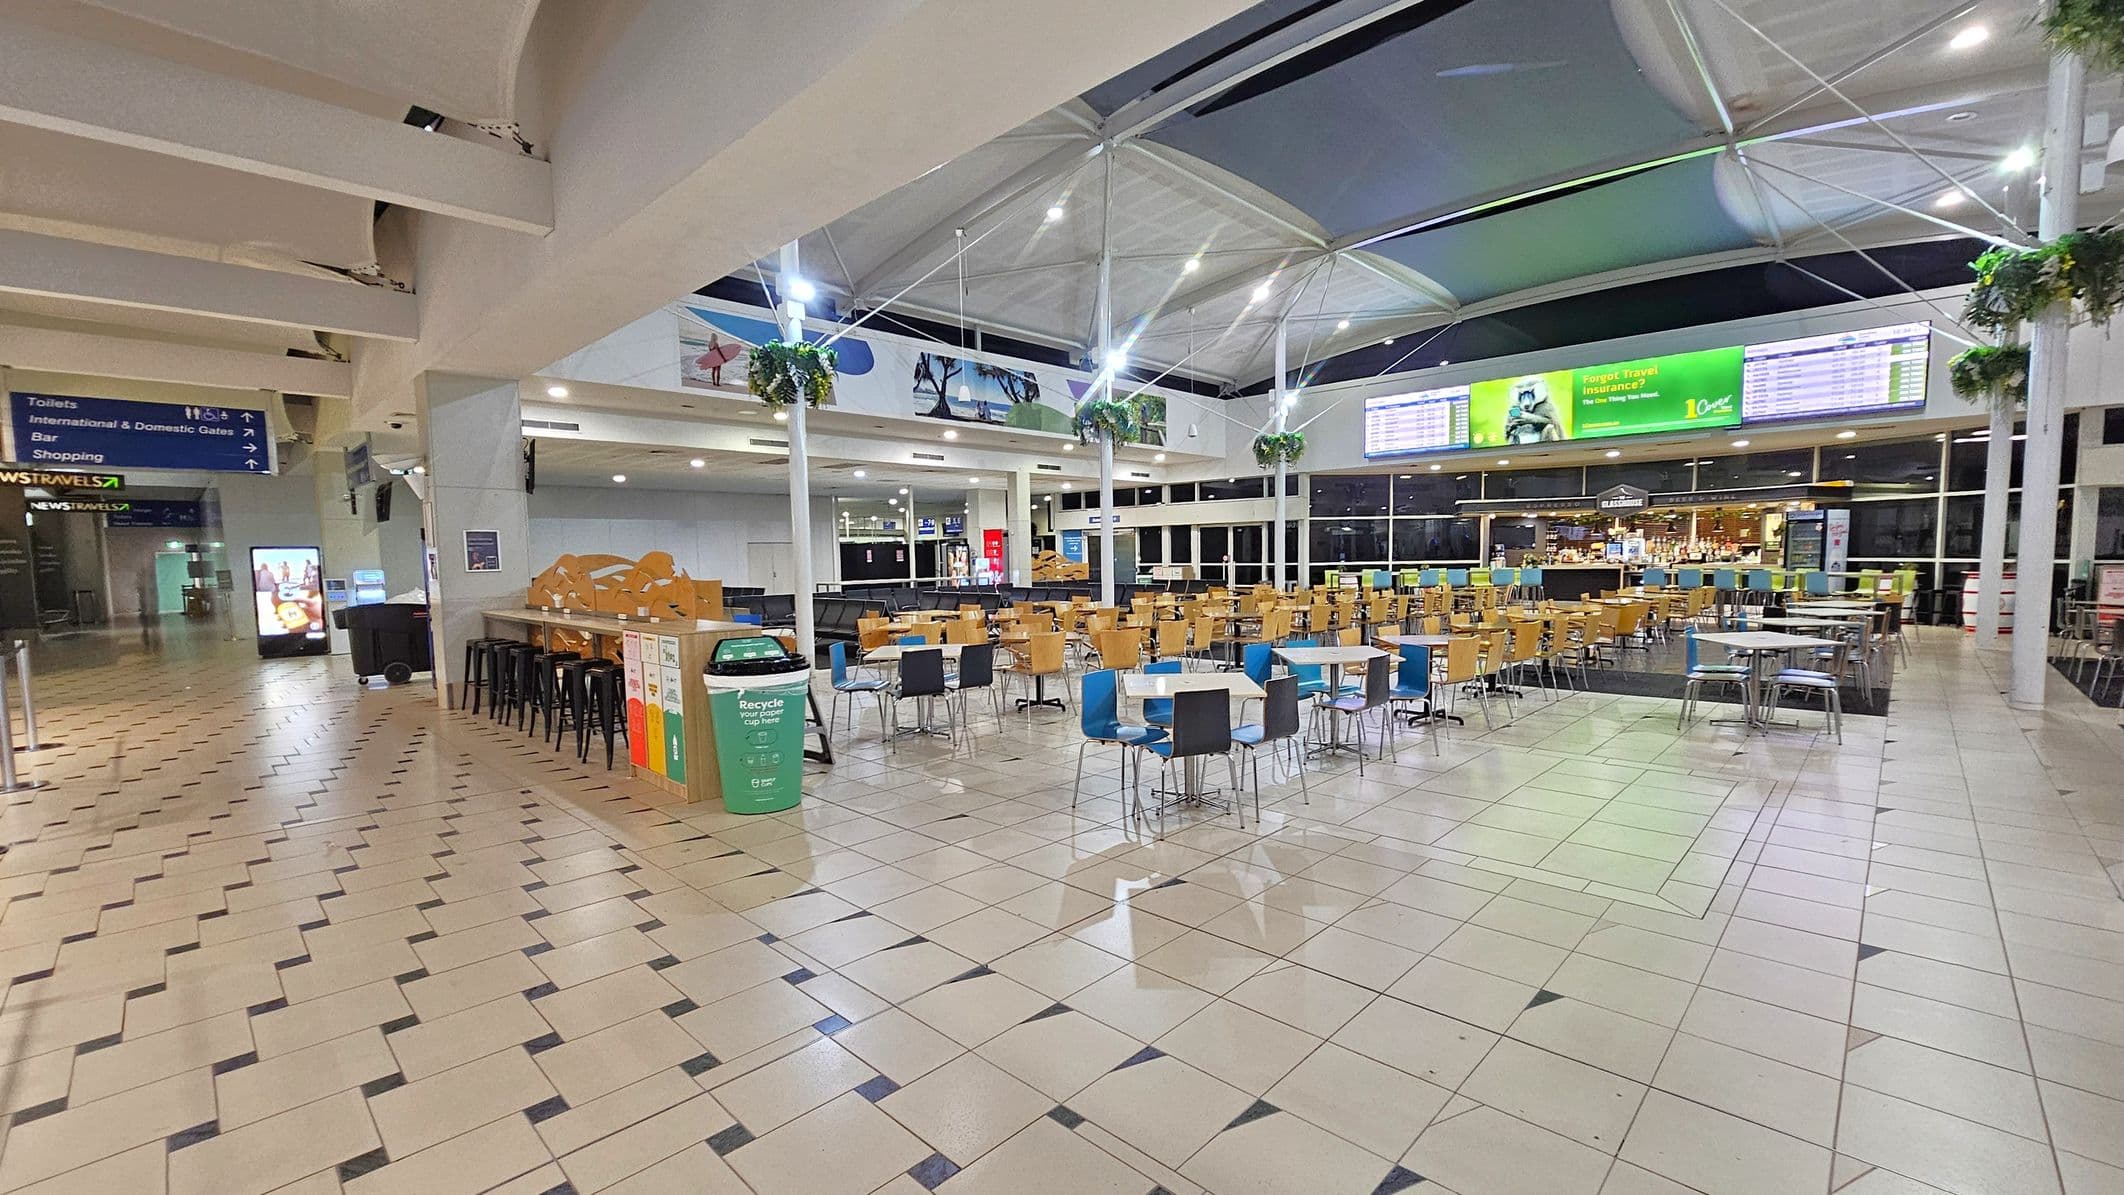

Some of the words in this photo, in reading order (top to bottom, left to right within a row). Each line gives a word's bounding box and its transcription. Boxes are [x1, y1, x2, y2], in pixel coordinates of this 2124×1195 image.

[1583, 372, 1620, 384] Forgot
[1624, 365, 1659, 378] Travel
[1583, 378, 1646, 395] Insurance?
[27, 397, 78, 409] Toilets
[29, 415, 117, 429] International
[120, 421, 131, 430] &
[134, 421, 195, 434] Domestic
[198, 426, 234, 436] Gates
[31, 432, 59, 442] Bar
[32, 449, 104, 463] Shopping
[30, 501, 119, 511] NEWSTRAVELS
[739, 698, 784, 711] Recycle
[739, 711, 758, 719] your
[759, 709, 784, 718] paper
[744, 719, 760, 727] cup
[761, 716, 780, 724] here
